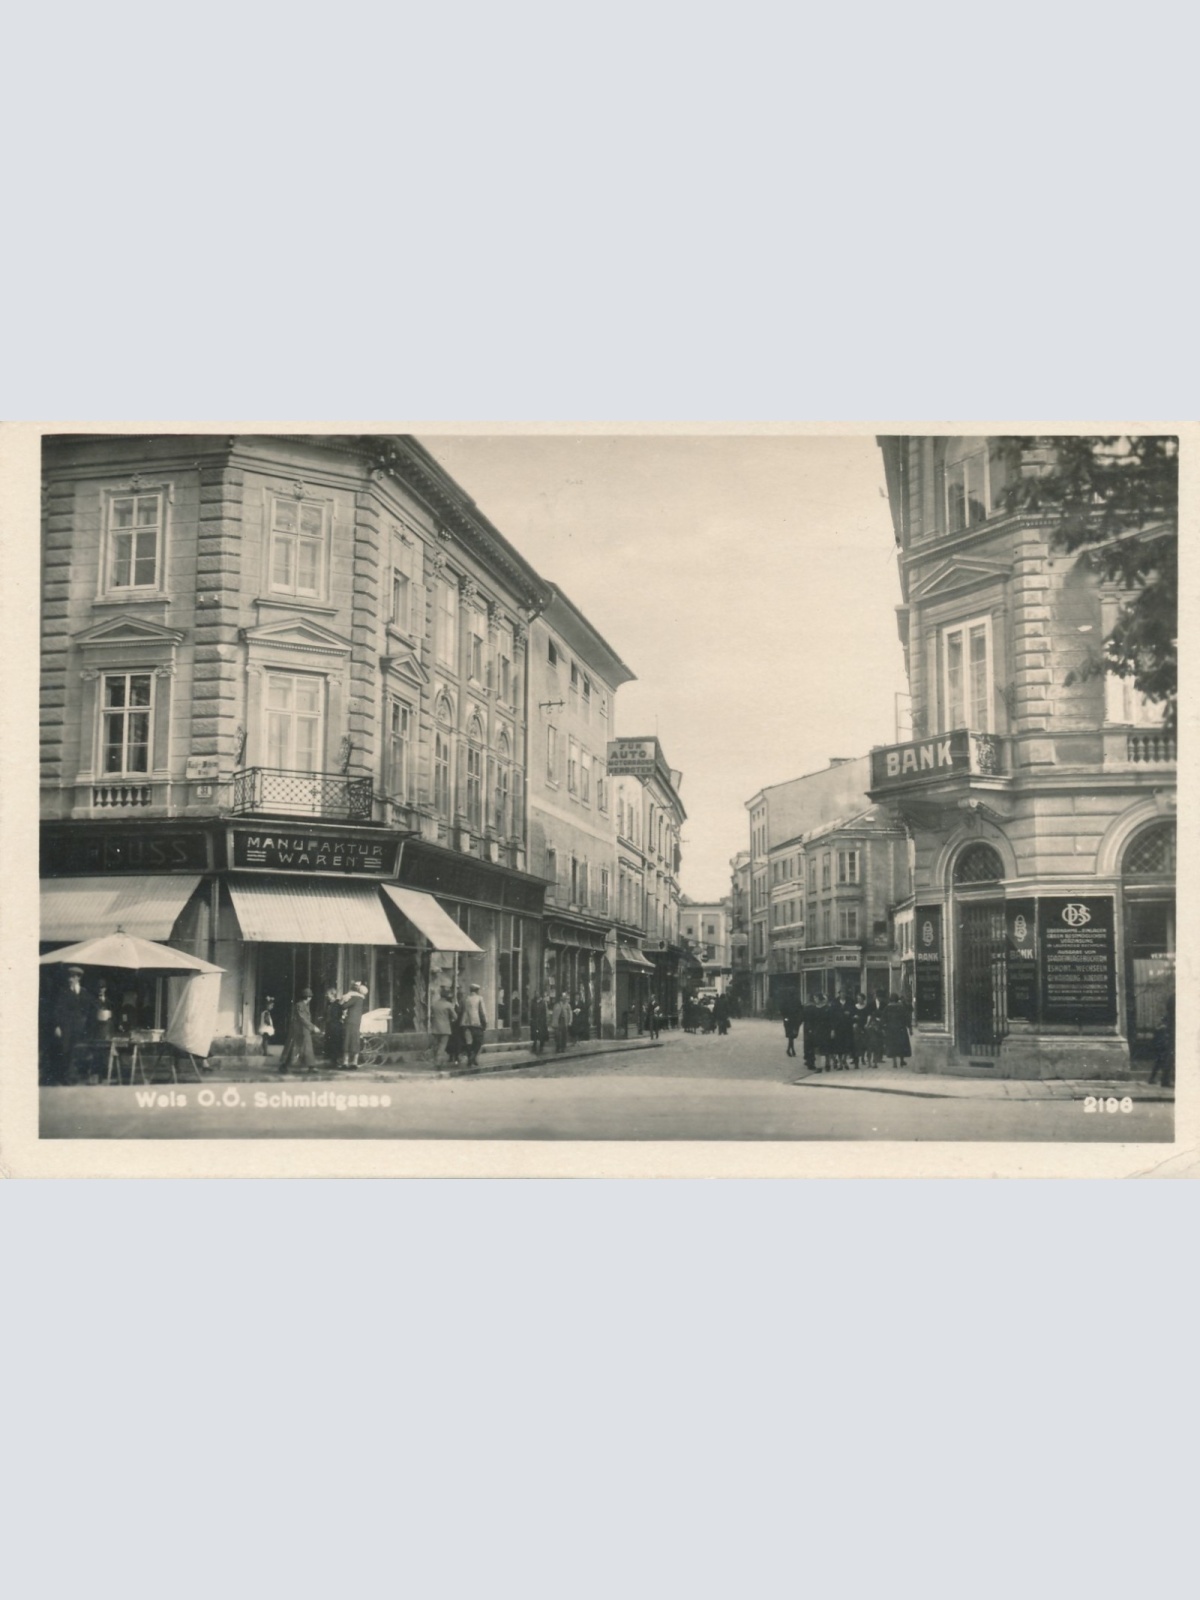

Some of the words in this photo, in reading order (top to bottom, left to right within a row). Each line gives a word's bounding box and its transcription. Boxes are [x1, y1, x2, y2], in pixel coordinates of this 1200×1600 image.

[610, 751, 647, 759] AUTO
[886, 740, 953, 777] BANK
[247, 836, 383, 856] MANUFAKTUR
[278, 852, 355, 867] WAREN
[917, 952, 938, 962] BANK
[1009, 948, 1034, 960] BANK
